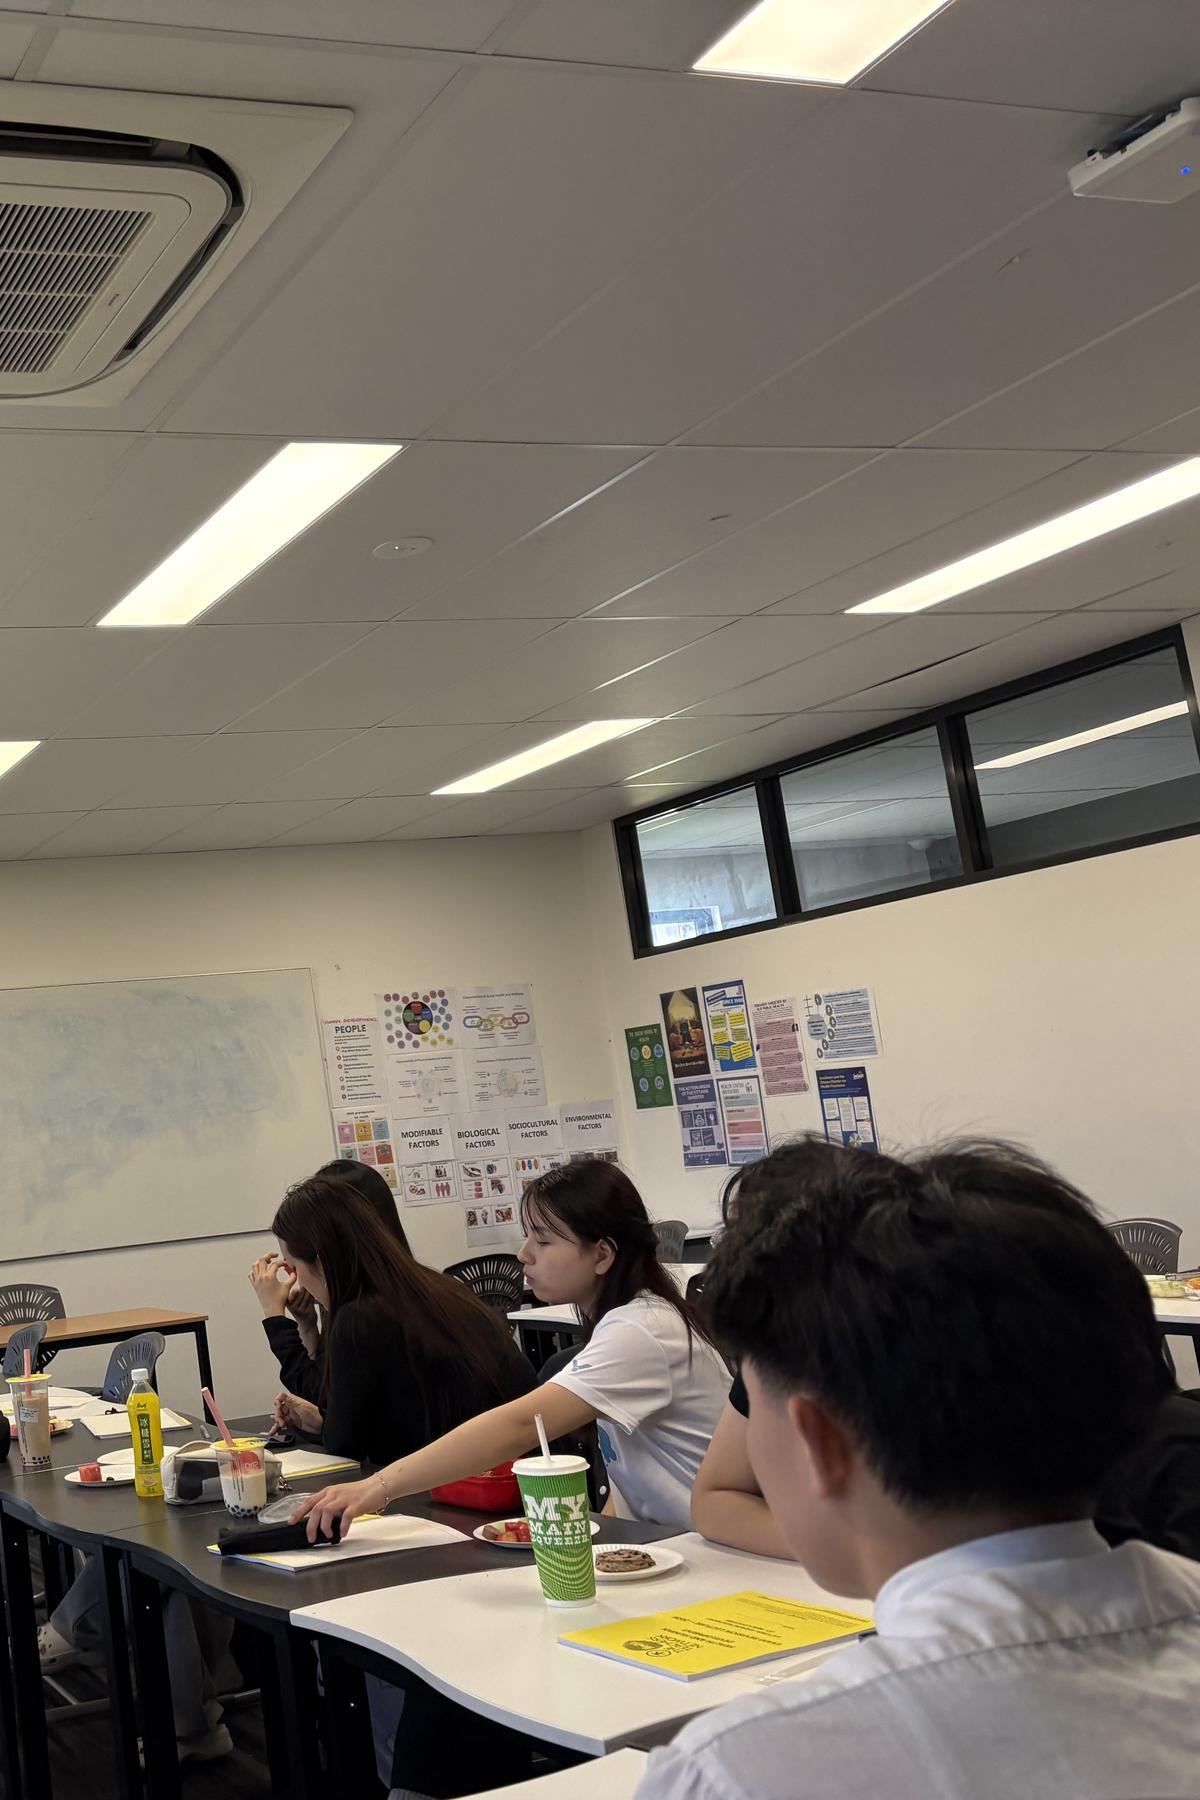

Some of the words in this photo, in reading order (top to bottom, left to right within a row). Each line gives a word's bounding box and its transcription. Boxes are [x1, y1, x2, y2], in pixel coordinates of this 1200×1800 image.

[335, 1024, 367, 1034] PEOPLE
[565, 1113, 612, 1123] ENVIRONMENTAL
[508, 1119, 559, 1130] SOCIOCULTURAL
[401, 1128, 443, 1139] MODIFIABLE
[457, 1128, 500, 1139] BIOLOGICAL
[521, 1130, 548, 1139] FACTORS
[409, 1140, 440, 1149] FACTORS
[465, 1140, 496, 1149] FACTORS
[524, 1493, 586, 1521] MY
[529, 1520, 586, 1536] MAIN
